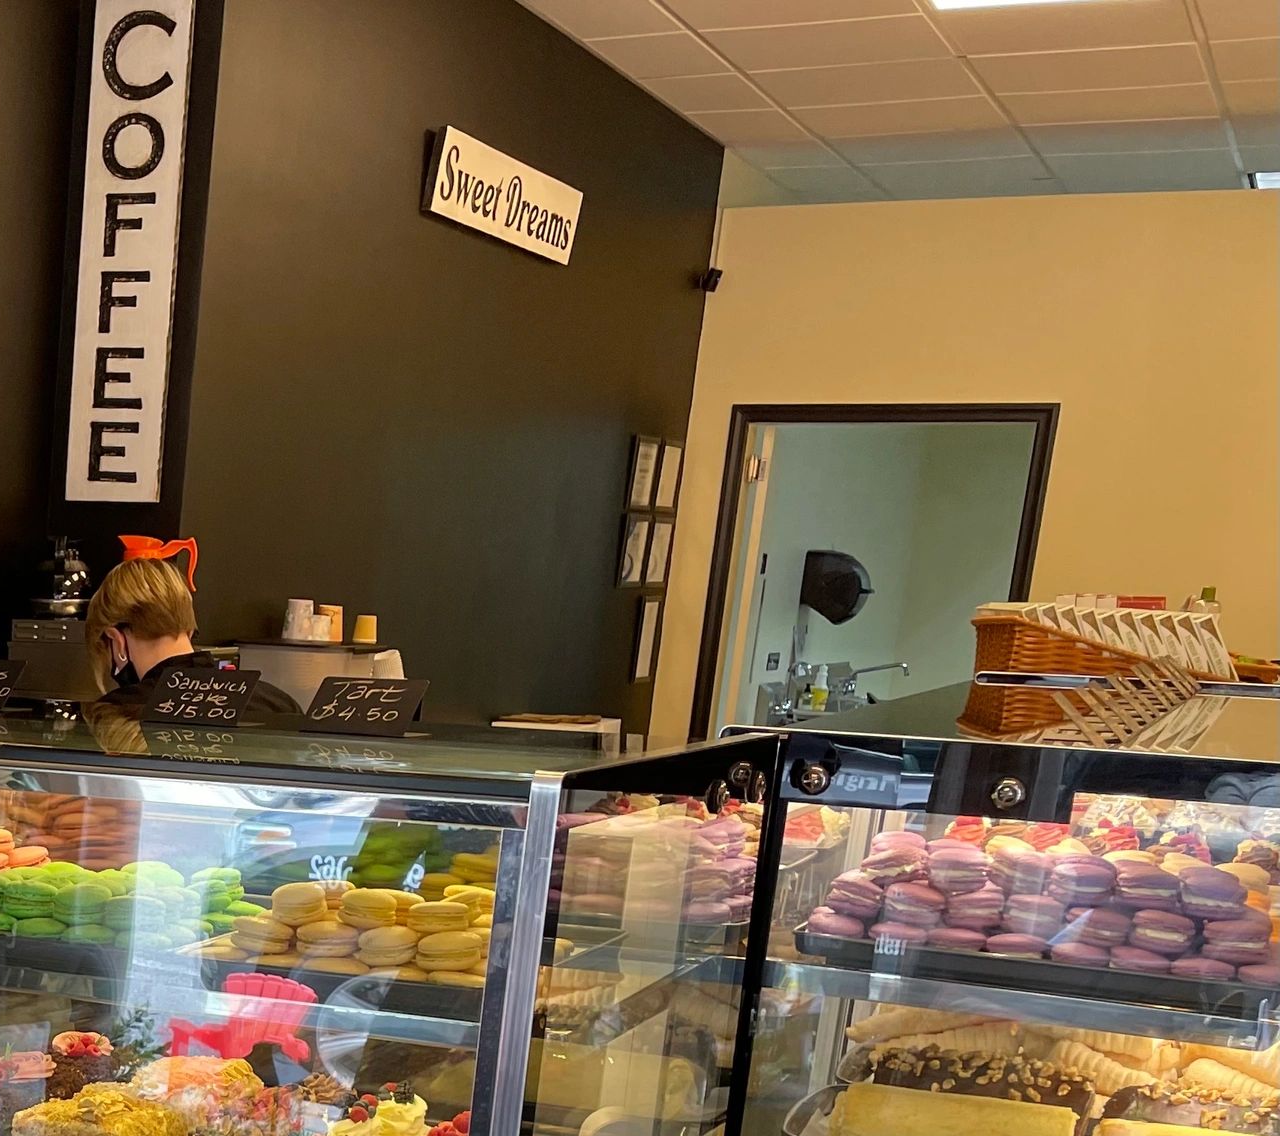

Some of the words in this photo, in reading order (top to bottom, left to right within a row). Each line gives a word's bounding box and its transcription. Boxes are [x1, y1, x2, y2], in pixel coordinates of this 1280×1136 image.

[440, 145, 504, 221] Sweet
[504, 176, 571, 250] Dreams
[88, 10, 177, 483] COFFEE
[167, 671, 247, 694] Sandwich
[333, 680, 407, 702] Tart
[155, 699, 237, 719] $15.00
[311, 699, 399, 721] $4.50
